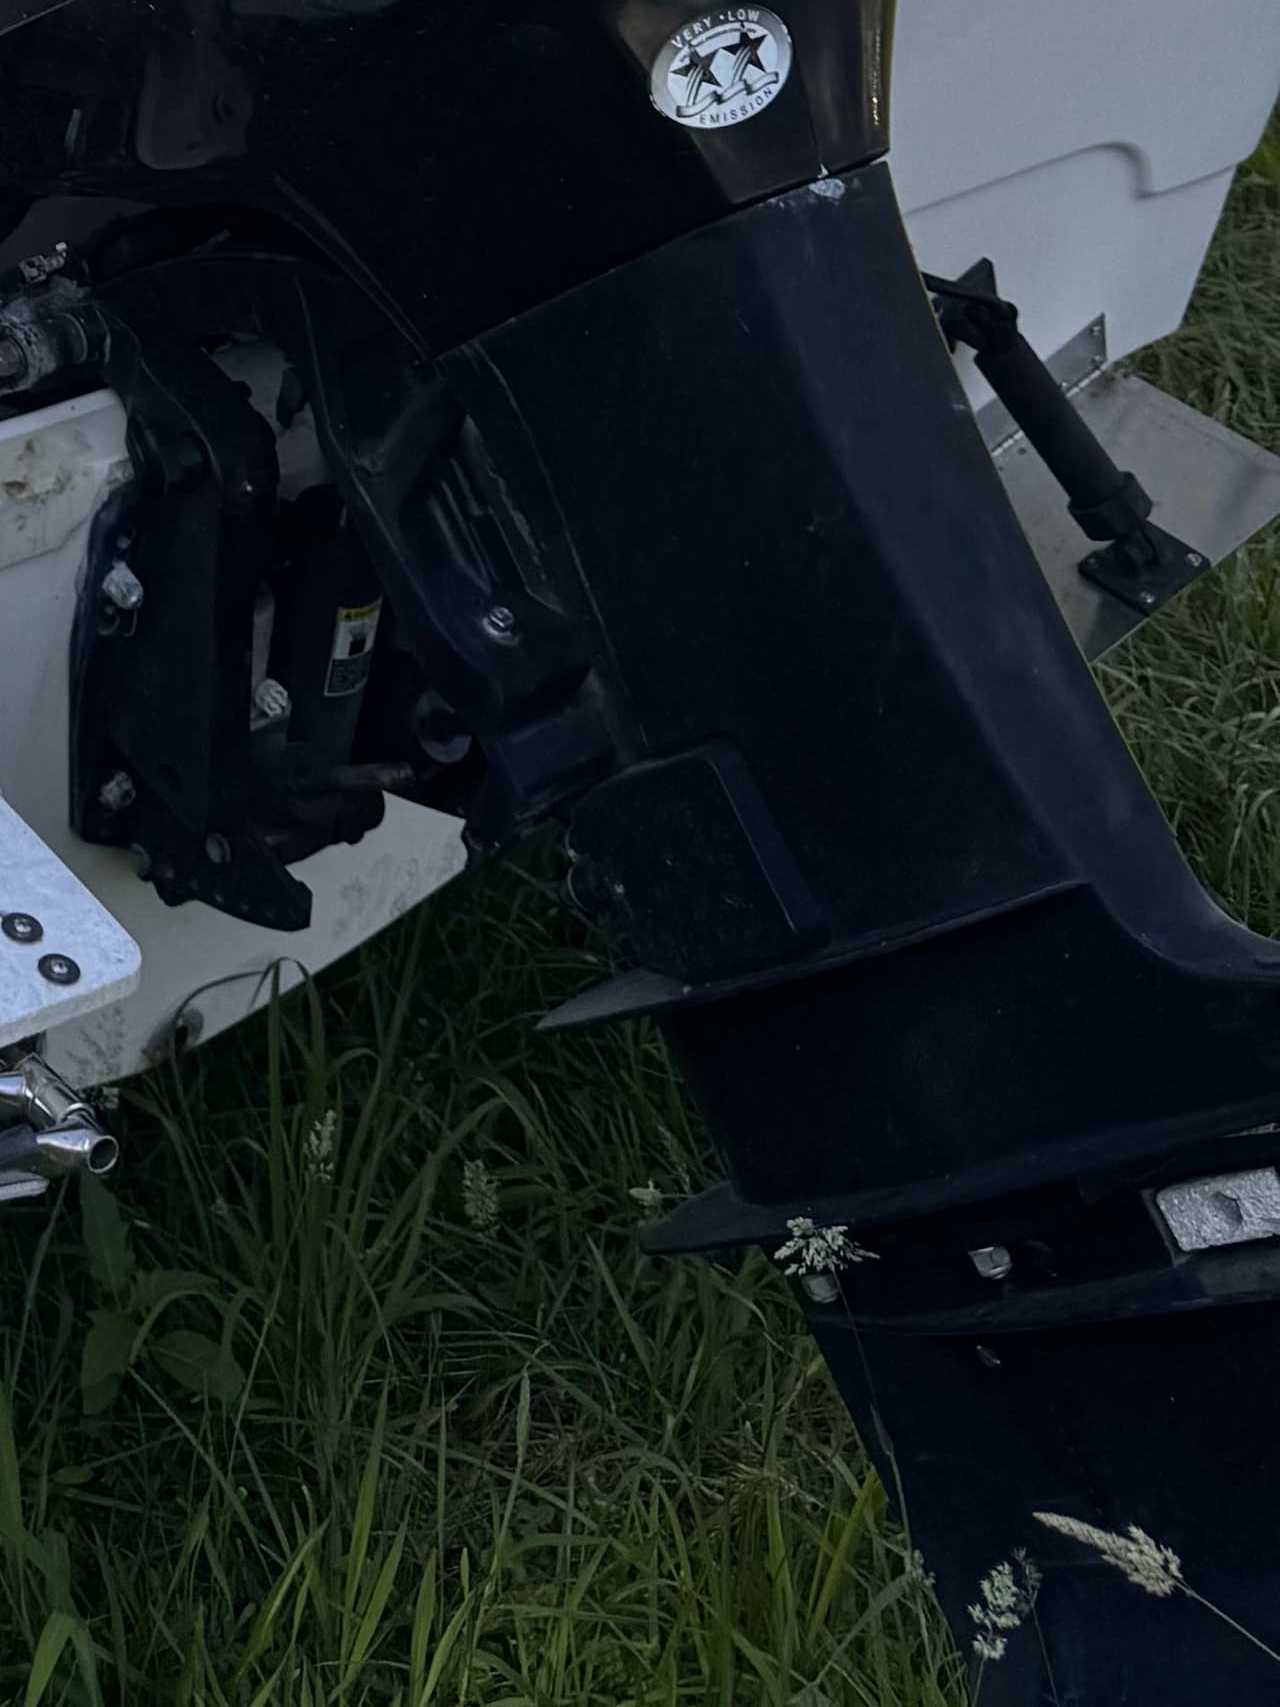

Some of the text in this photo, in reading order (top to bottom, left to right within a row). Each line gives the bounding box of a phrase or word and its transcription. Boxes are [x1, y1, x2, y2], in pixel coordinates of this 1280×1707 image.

[671, 8, 760, 49] VERY LOW
[699, 87, 774, 125] EMISSION
